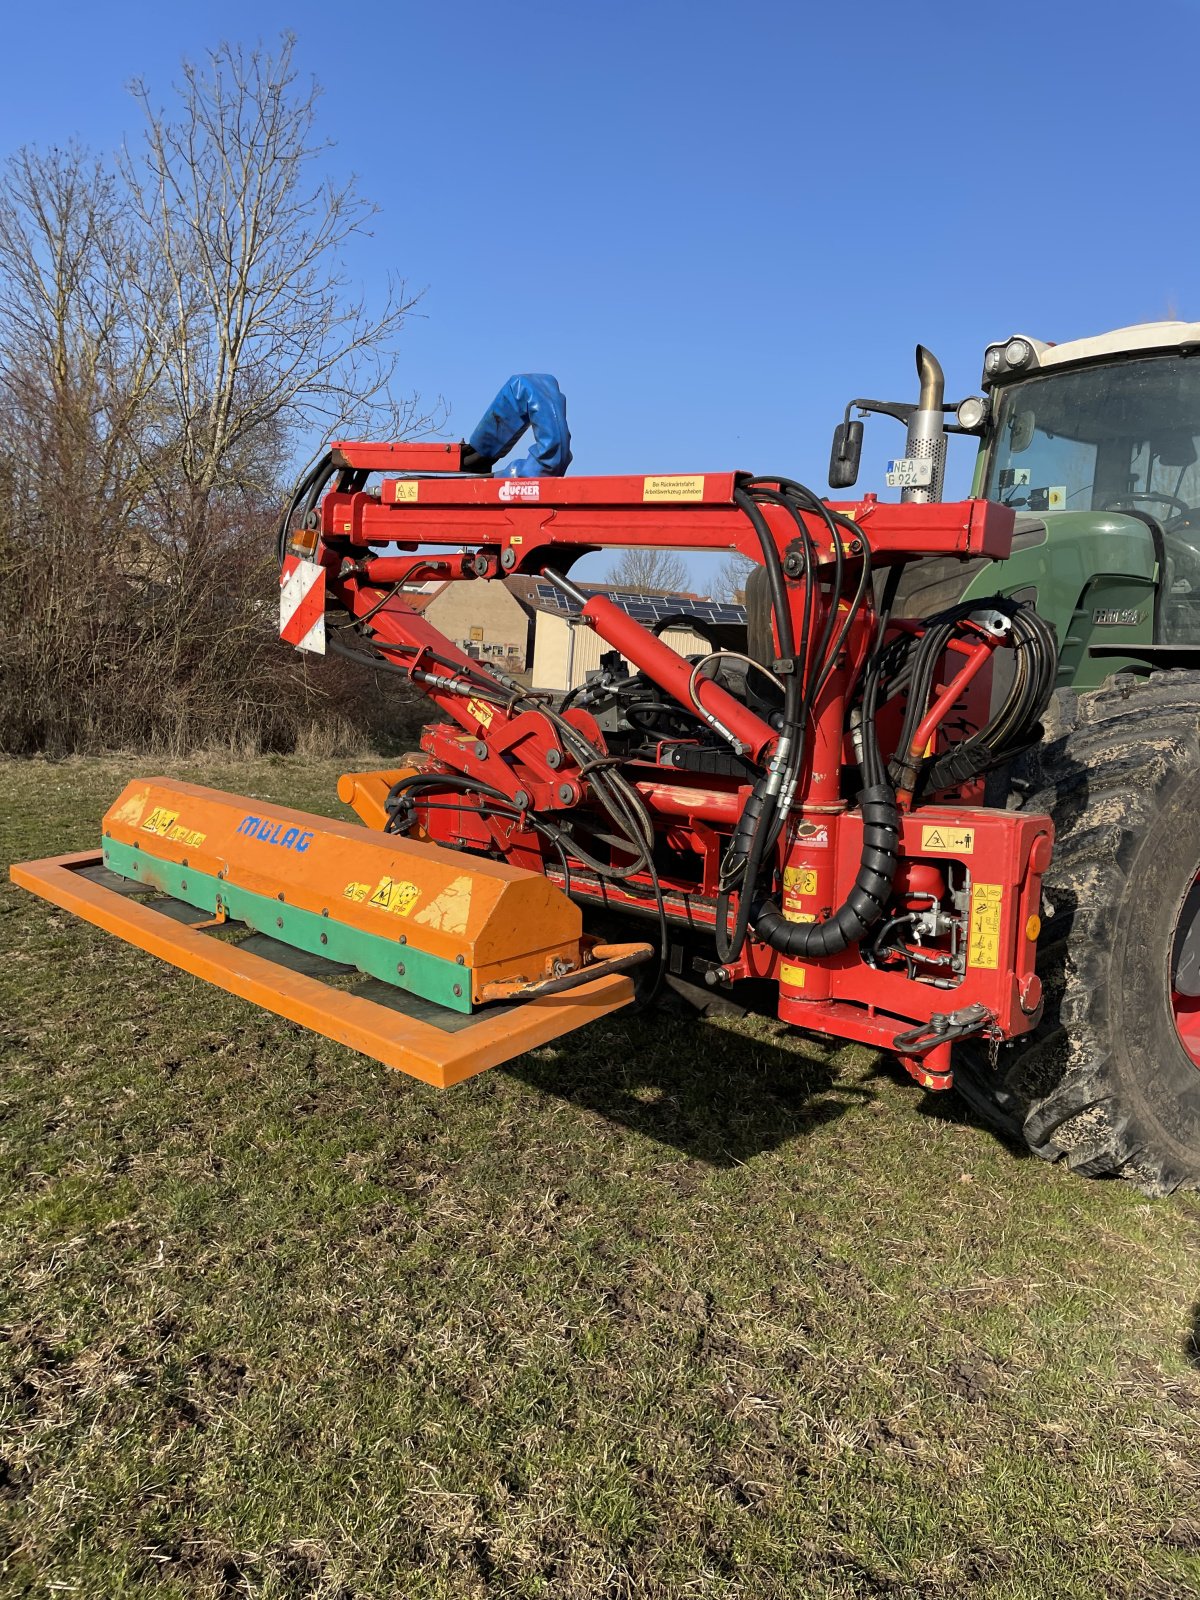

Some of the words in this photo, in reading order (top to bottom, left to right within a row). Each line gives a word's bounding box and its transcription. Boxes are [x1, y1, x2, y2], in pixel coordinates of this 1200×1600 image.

[893, 461, 914, 473] NEA
[888, 474, 895, 485] G
[898, 473, 918, 485] 924
